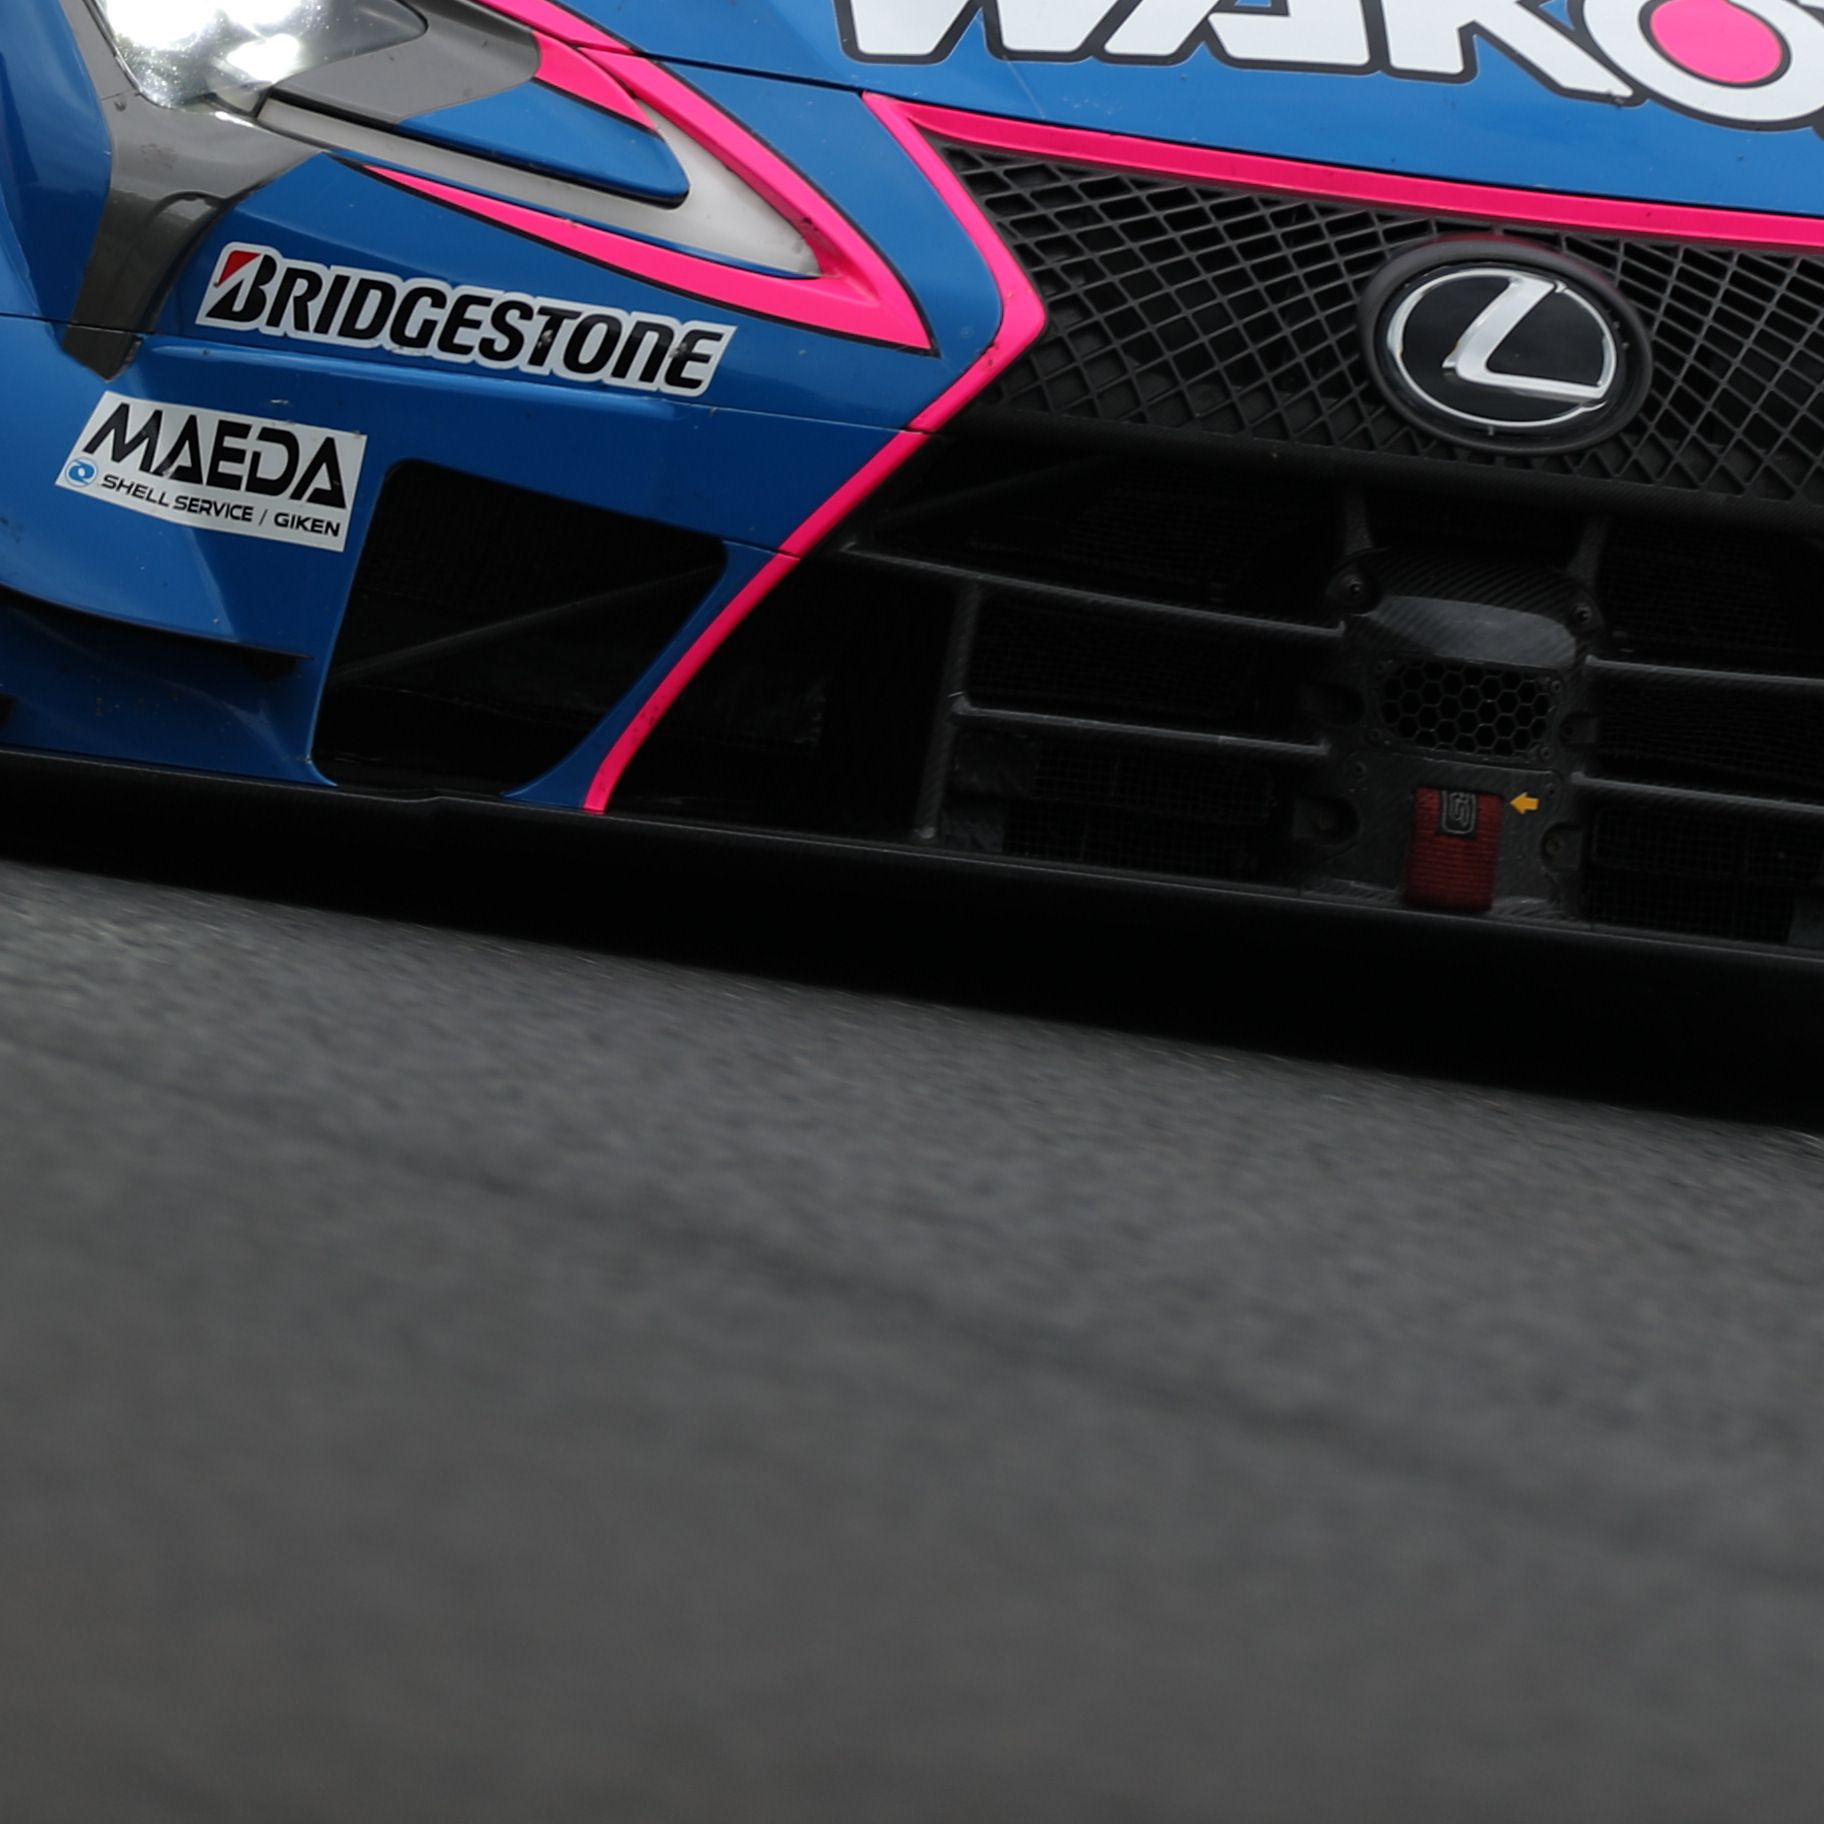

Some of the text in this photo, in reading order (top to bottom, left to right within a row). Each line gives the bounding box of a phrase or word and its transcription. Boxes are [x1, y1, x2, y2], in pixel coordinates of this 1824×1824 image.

[205, 249, 725, 390] BRIDGESTONE
[82, 402, 347, 509] MAEDA
[101, 473, 170, 509] SHELL
[173, 494, 254, 524] SERVICE
[273, 510, 342, 537] GIKEN
